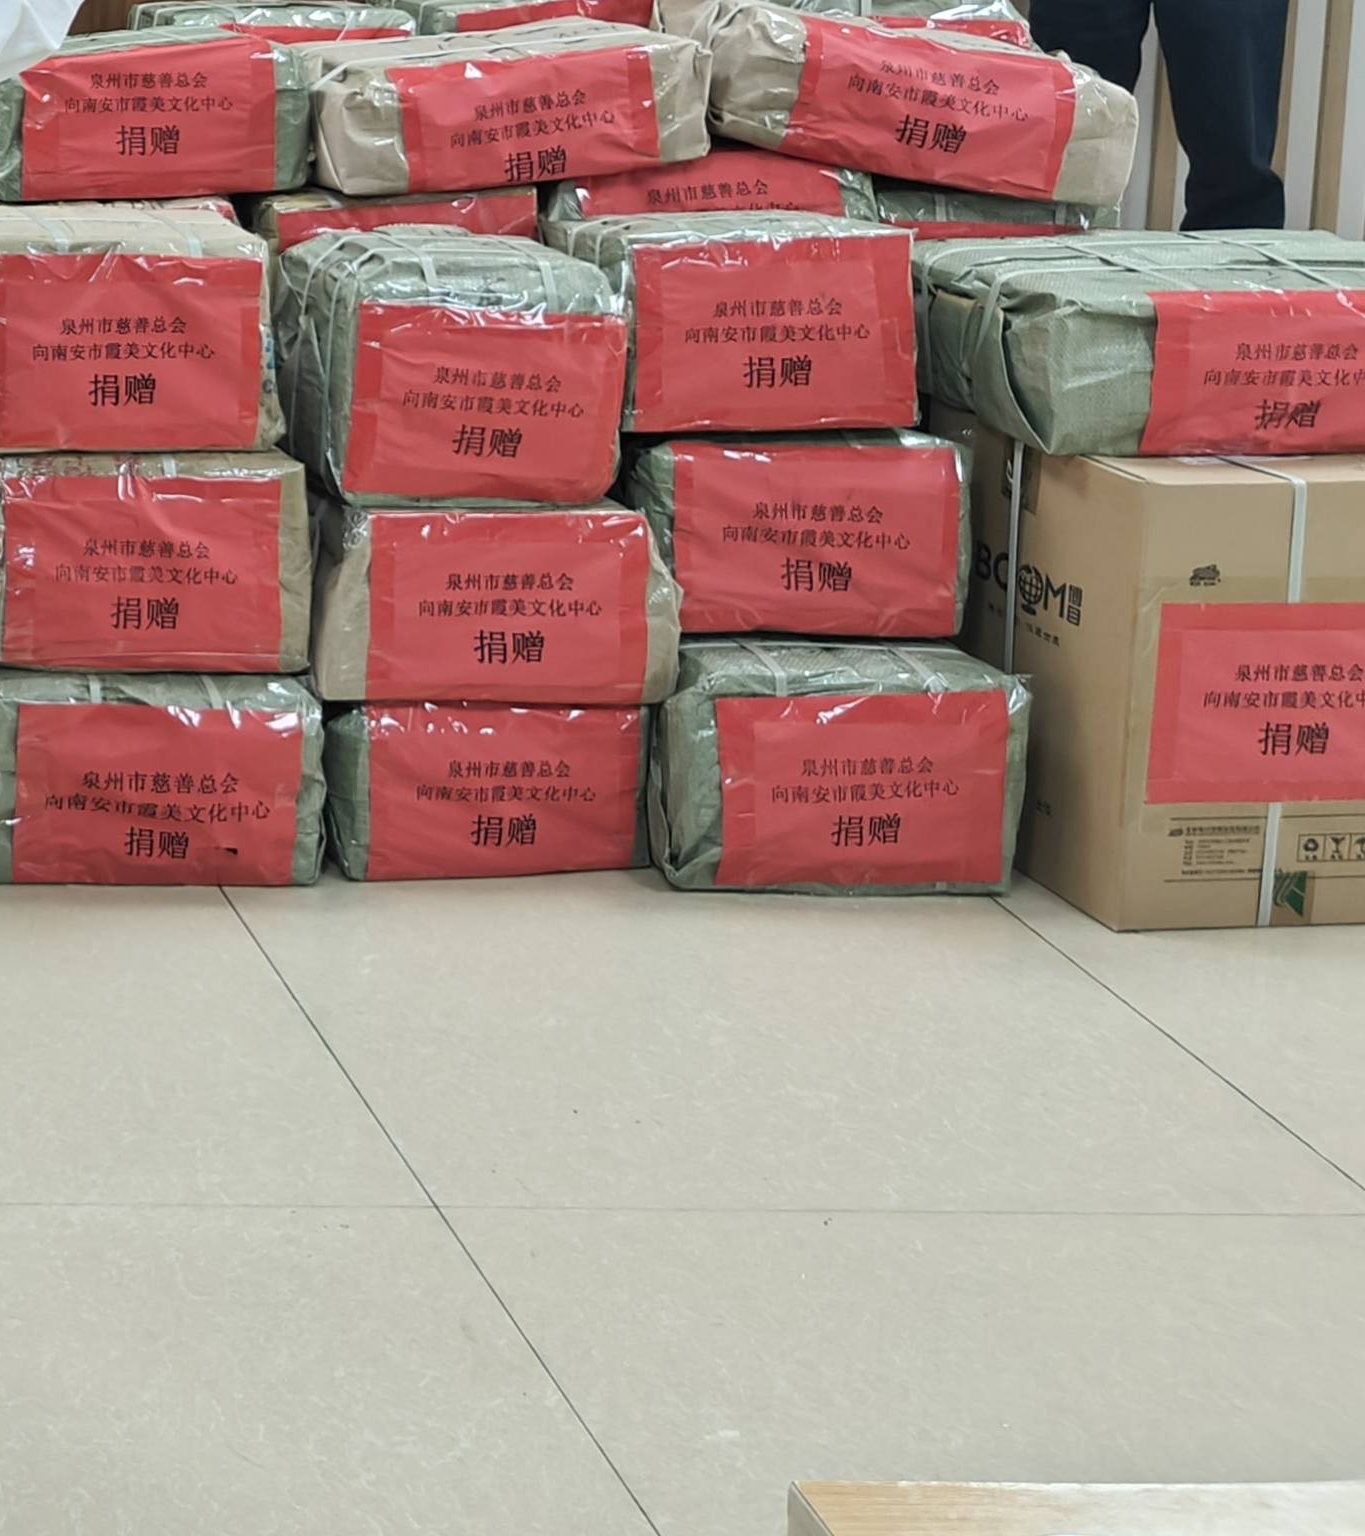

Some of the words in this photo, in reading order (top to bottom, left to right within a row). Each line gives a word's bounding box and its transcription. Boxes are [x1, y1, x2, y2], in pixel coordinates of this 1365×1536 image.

[89, 71, 207, 90] 泉州市慈善总会
[879, 59, 999, 96] 泉州市慈善总会
[64, 95, 233, 115] 向南安市霞美文化中心
[474, 89, 587, 120] 泉州市慈善总会
[848, 73, 1029, 123] 向南安市霞美文化中心
[115, 124, 181, 157] 捐赠
[450, 112, 615, 148] 向南安市霞美文化中心
[895, 114, 967, 154] 捐赠
[503, 147, 568, 183] 捐赠
[647, 179, 768, 204] 泉州市慈善总会
[713, 298, 843, 318] 泉州市慈善总会
[60, 316, 187, 334] 泉州市慈善总会
[684, 323, 870, 344] 向南安市霞美文化中心
[32, 341, 215, 361] 向南安市霞美文化中心
[1235, 342, 1358, 362] 泉州市慈善总会
[433, 365, 561, 393] 泉州市慈善总会
[743, 355, 812, 388] 捐赠
[88, 373, 157, 407] 捐赠
[403, 388, 584, 418] 向南安市霞美文化中心
[1254, 398, 1322, 430] 捐赠
[452, 424, 523, 458] 捐赠
[753, 501, 884, 523] 泉州市慈善总会
[83, 538, 211, 560] 泉州市慈善总会
[722, 524, 911, 550] 向南安市霞美文化中心
[55, 564, 238, 585] 向南安市霞美文化中心
[446, 571, 575, 592] 泉州市慈善总会
[780, 557, 853, 593] 捐赠
[111, 597, 180, 630] 捐赠
[418, 598, 603, 618] 向南安市霞美文化中心
[473, 629, 545, 664] 捐赠
[1234, 664, 1364, 683] 泉州市慈善总会
[1257, 721, 1330, 756] 捐赠
[448, 759, 571, 779] 泉州市慈善总会
[801, 756, 934, 779] 泉州市慈善总会
[82, 770, 240, 796] 泉州市慈善总会
[416, 785, 596, 804] 向南安市霞美文化中心
[771, 778, 961, 805] 向南安市霞美文化中心
[44, 792, 271, 823] 向南安市霞美文化中心
[123, 826, 191, 860] 捐赠
[470, 813, 538, 847] 捐赠
[831, 813, 902, 848] 捐赠
